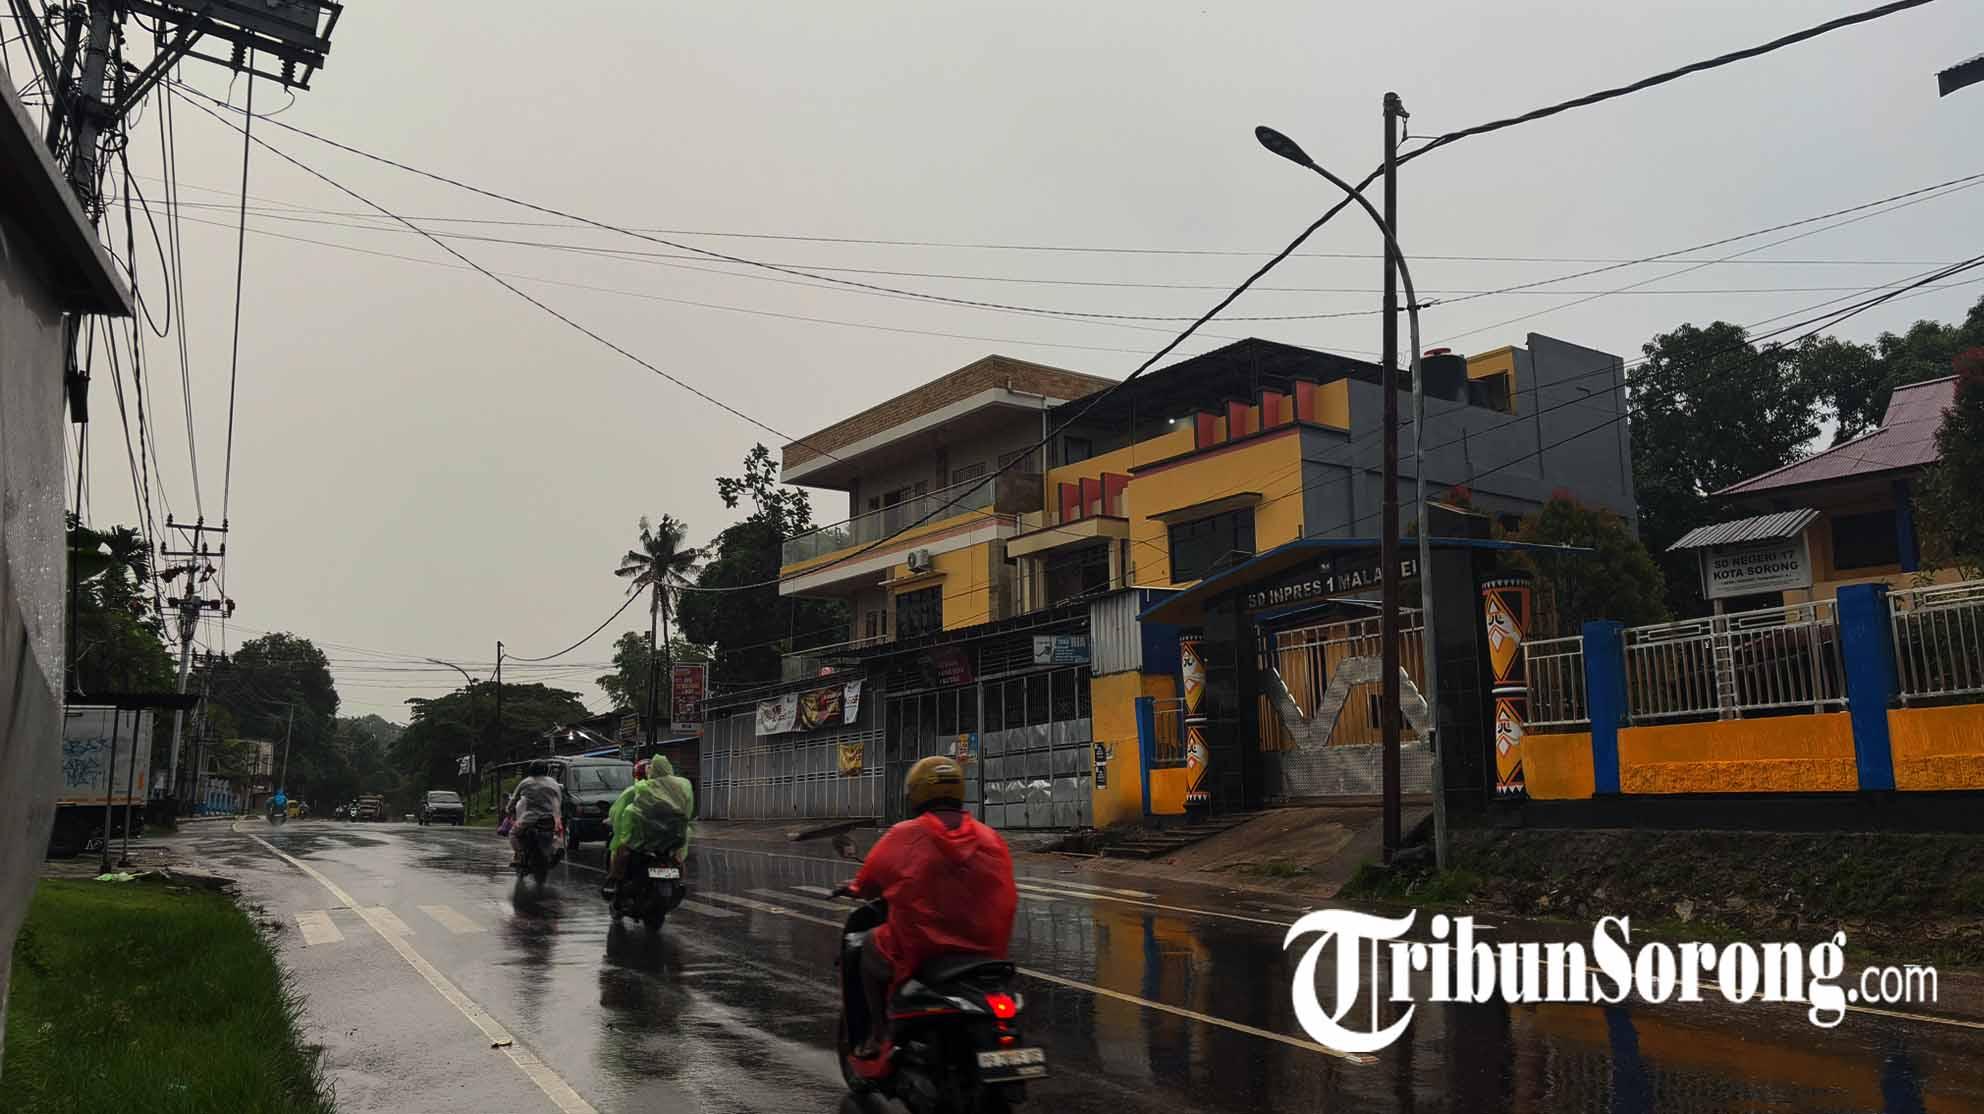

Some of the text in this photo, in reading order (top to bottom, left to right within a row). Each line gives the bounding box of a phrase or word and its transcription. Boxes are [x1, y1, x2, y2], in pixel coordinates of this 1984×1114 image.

[1714, 559, 1729, 569] SD
[1732, 551, 1777, 567] NEGERI
[1713, 568, 1744, 580] KOTA
[1747, 561, 1799, 575] SORONG
[1248, 559, 1417, 609] SD INPRES 1 MALAEI
